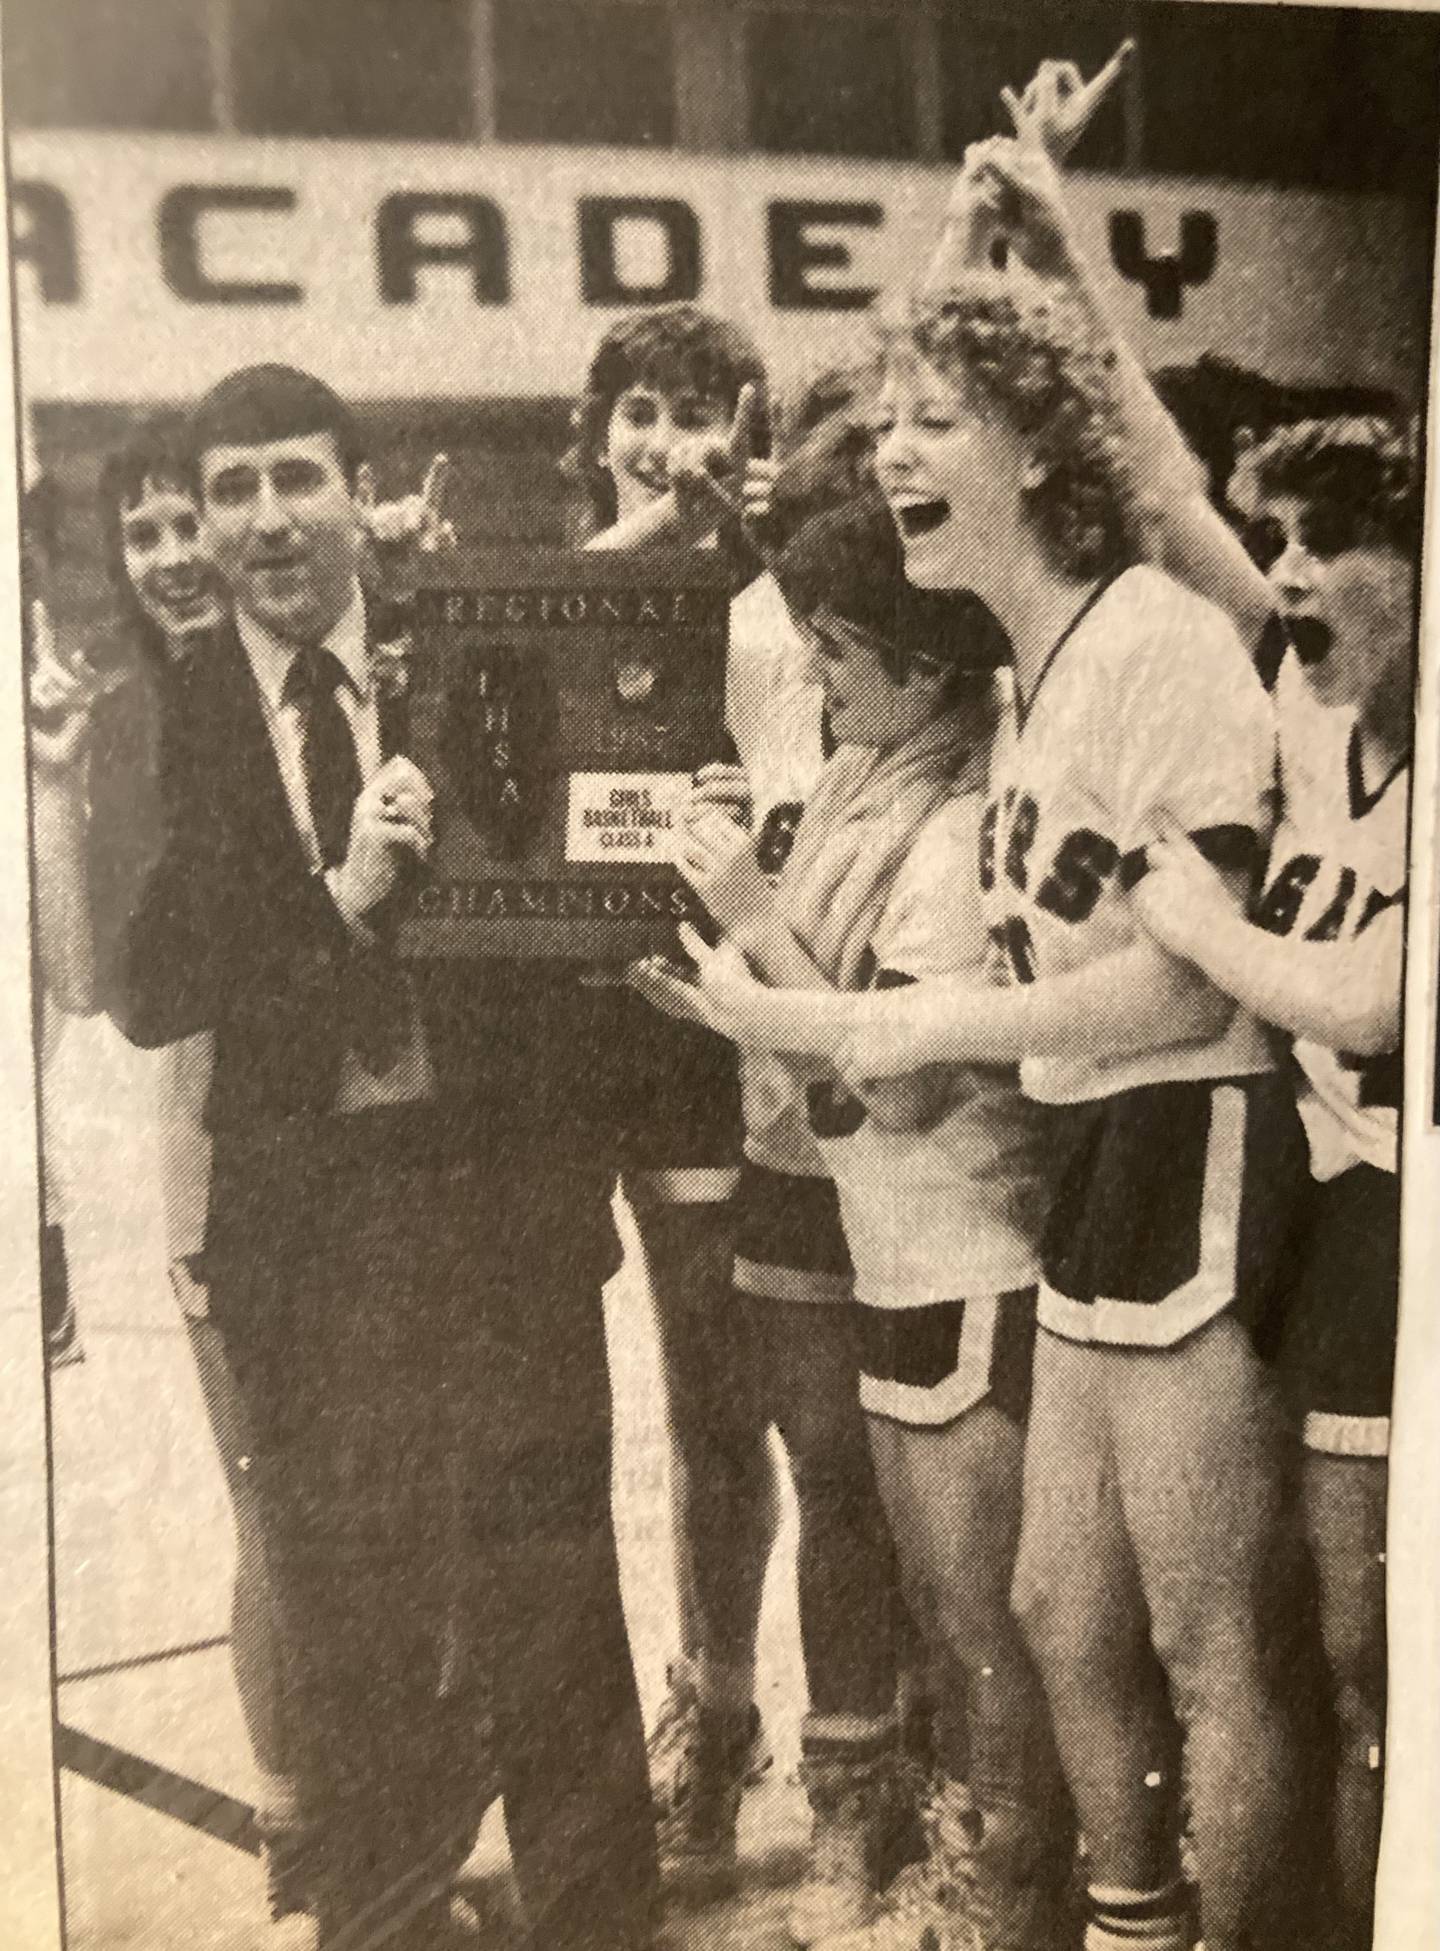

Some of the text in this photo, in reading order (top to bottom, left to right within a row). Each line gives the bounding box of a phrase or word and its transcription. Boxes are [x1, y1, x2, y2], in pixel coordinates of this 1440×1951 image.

[443, 593, 687, 623] REGIONAL
[600, 831, 641, 849] CLASS
[417, 886, 689, 915] CHAMPIONS
